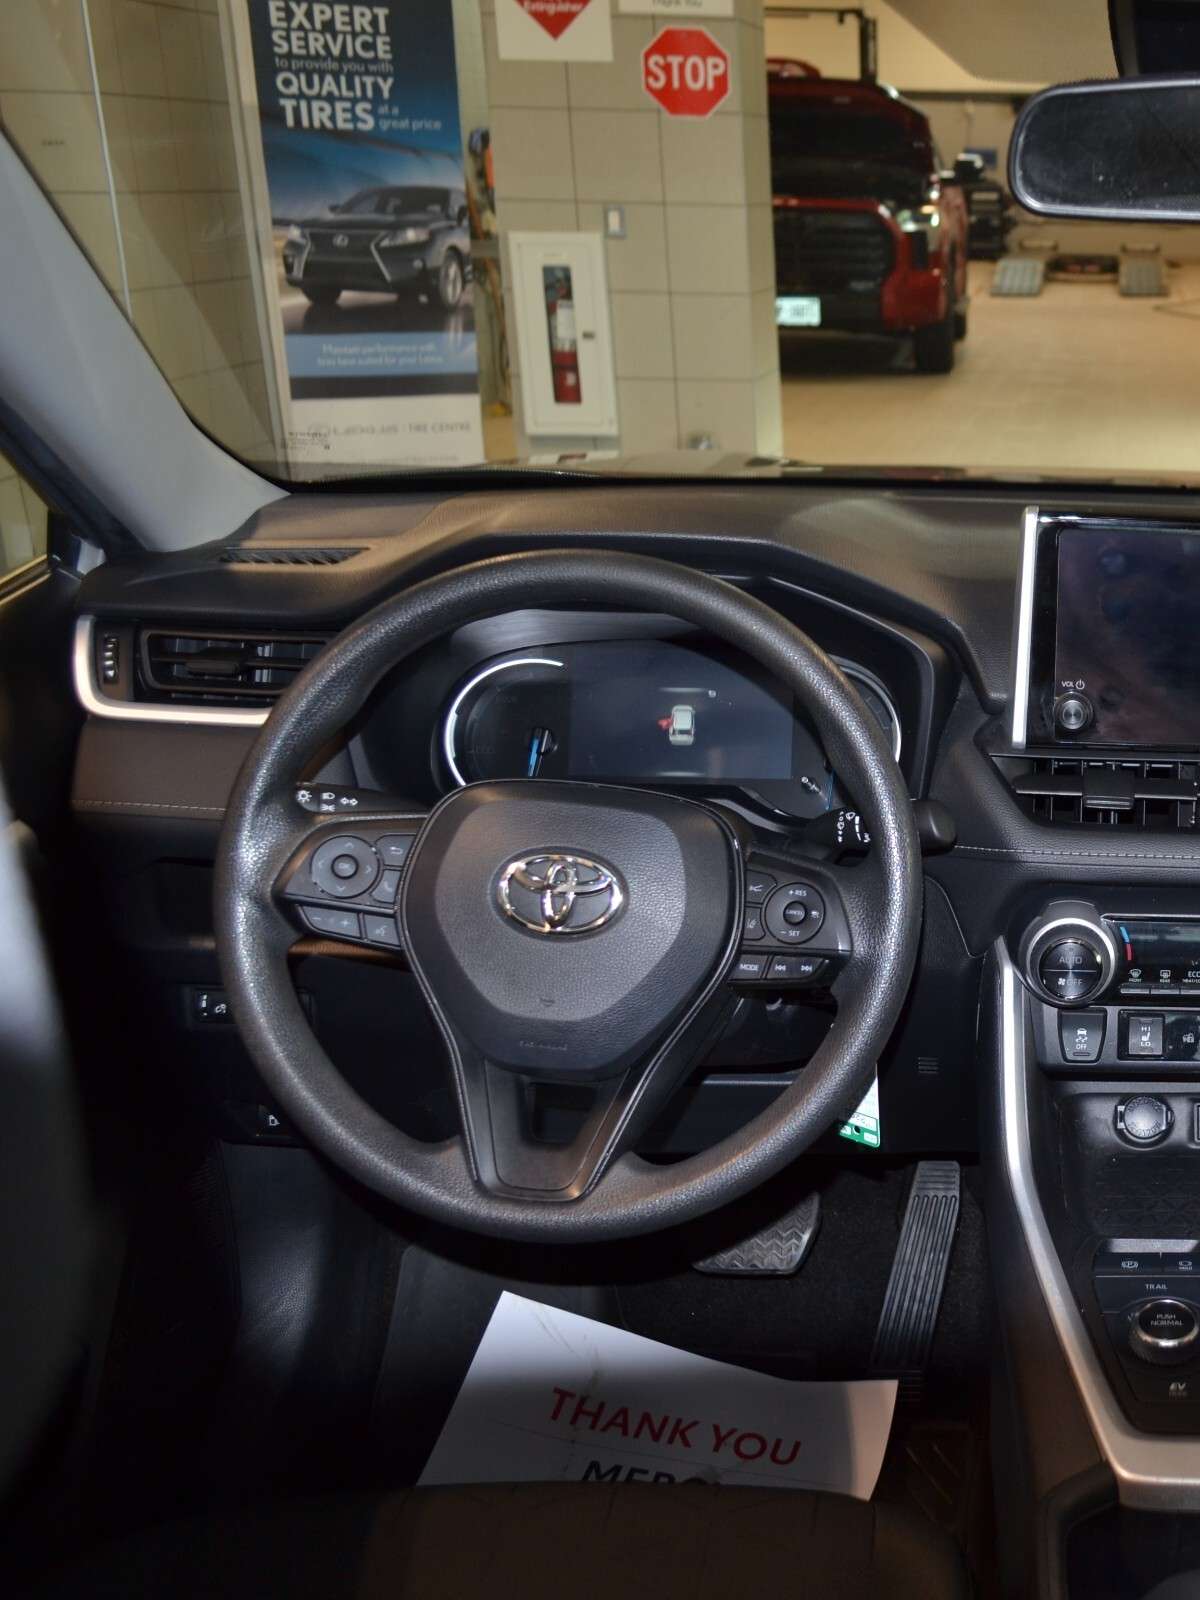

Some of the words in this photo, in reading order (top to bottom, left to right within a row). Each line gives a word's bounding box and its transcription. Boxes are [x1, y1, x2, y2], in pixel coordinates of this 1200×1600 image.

[268, 0, 389, 34] EXPERT
[272, 30, 393, 60] SERVICE
[275, 58, 288, 68] to
[292, 58, 339, 72] provide
[343, 61, 364, 73] you
[368, 61, 394, 73] with
[647, 54, 726, 91] STOP
[276, 71, 394, 99] QUALITY
[280, 98, 375, 130] TIRES
[740, 963, 759, 971] MODE
[1059, 956, 1082, 964] AUTO
[1169, 1382, 1186, 1391] EV
[550, 1387, 699, 1448] THANK
[711, 1423, 802, 1466] YOU
